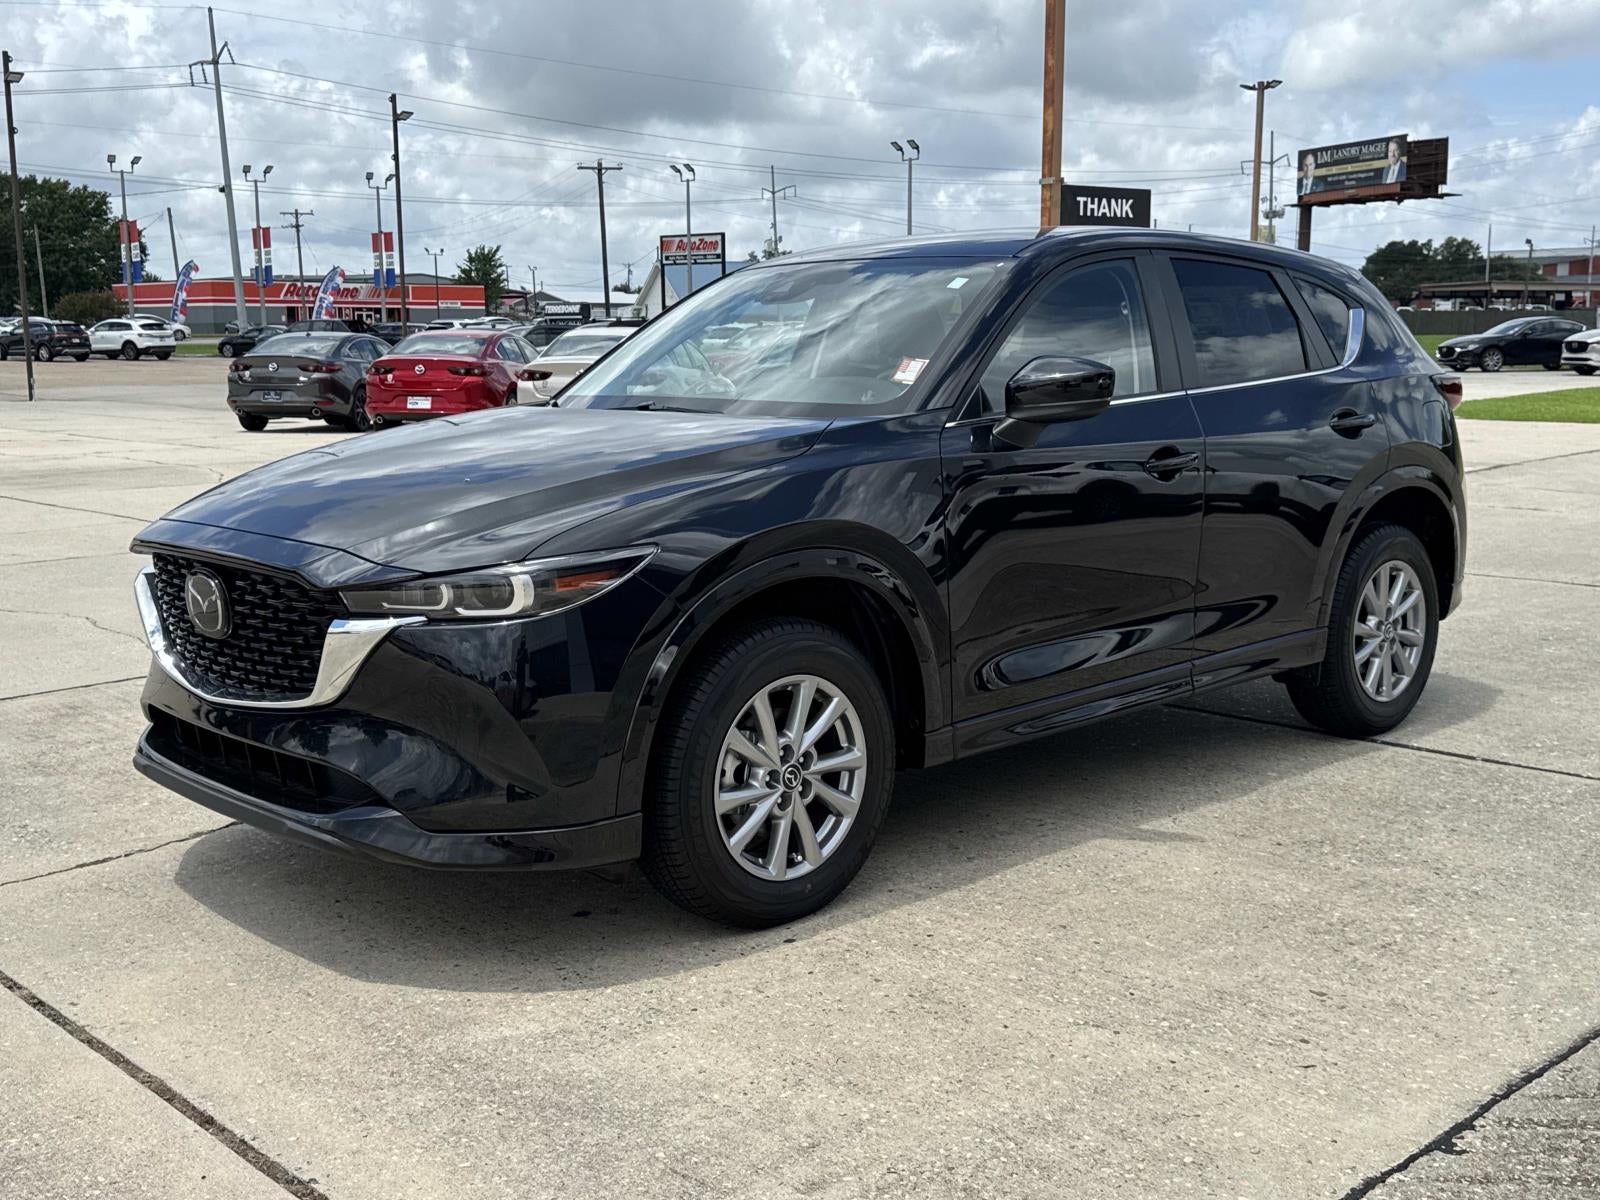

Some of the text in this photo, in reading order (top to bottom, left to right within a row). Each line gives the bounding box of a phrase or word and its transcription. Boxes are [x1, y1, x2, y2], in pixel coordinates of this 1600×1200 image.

[1361, 142, 1387, 154] MAGEE
[1076, 196, 1134, 218] THANK
[675, 238, 719, 252] AuoZone
[283, 282, 359, 298] Autone
